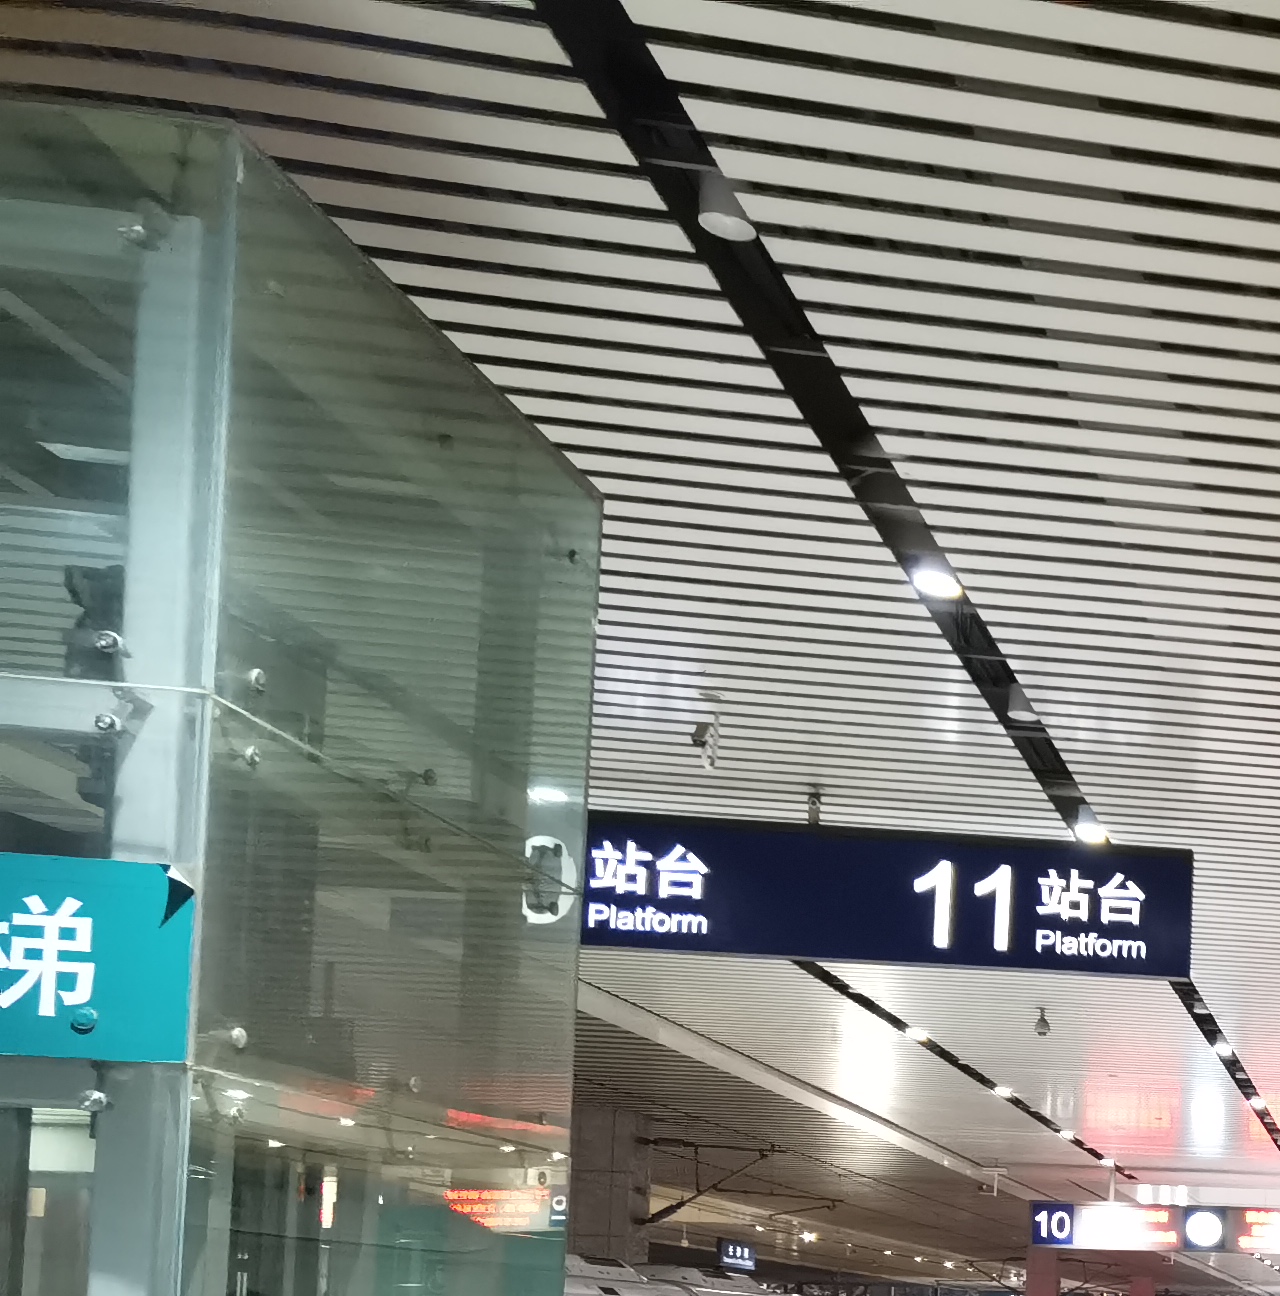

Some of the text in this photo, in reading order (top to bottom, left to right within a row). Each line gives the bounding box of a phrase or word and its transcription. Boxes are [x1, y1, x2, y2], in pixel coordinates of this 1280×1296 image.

[589, 840, 711, 900] 站台
[588, 903, 709, 935] Platform
[913, 859, 1147, 952] 11 站台
[1035, 929, 1147, 960] Platform
[1034, 1210, 1071, 1239] 10
